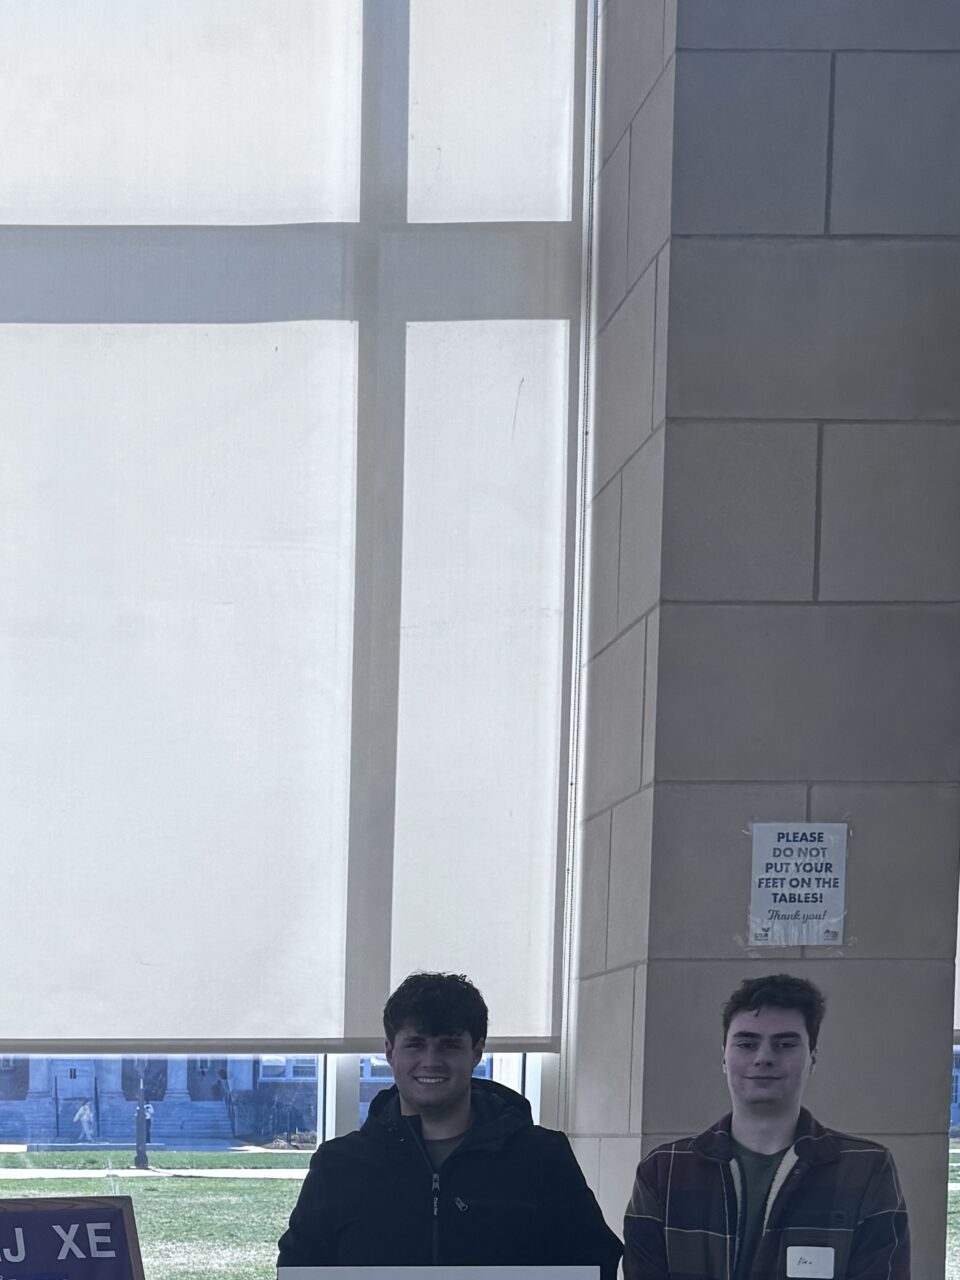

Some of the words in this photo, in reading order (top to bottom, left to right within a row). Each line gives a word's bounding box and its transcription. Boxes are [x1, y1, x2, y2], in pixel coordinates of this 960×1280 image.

[777, 832, 824, 843] PLEASE
[772, 847, 794, 858] DO
[797, 847, 828, 858] NOT
[765, 862, 792, 873] PUT
[794, 862, 833, 873] YOUR
[757, 878, 786, 888] FEET
[789, 878, 811, 888] ON
[815, 878, 839, 888] THE
[772, 893, 823, 904] TABLES!
[767, 909, 800, 921] Thank
[802, 909, 827, 924] you!
[52, 1222, 116, 1260] XE
